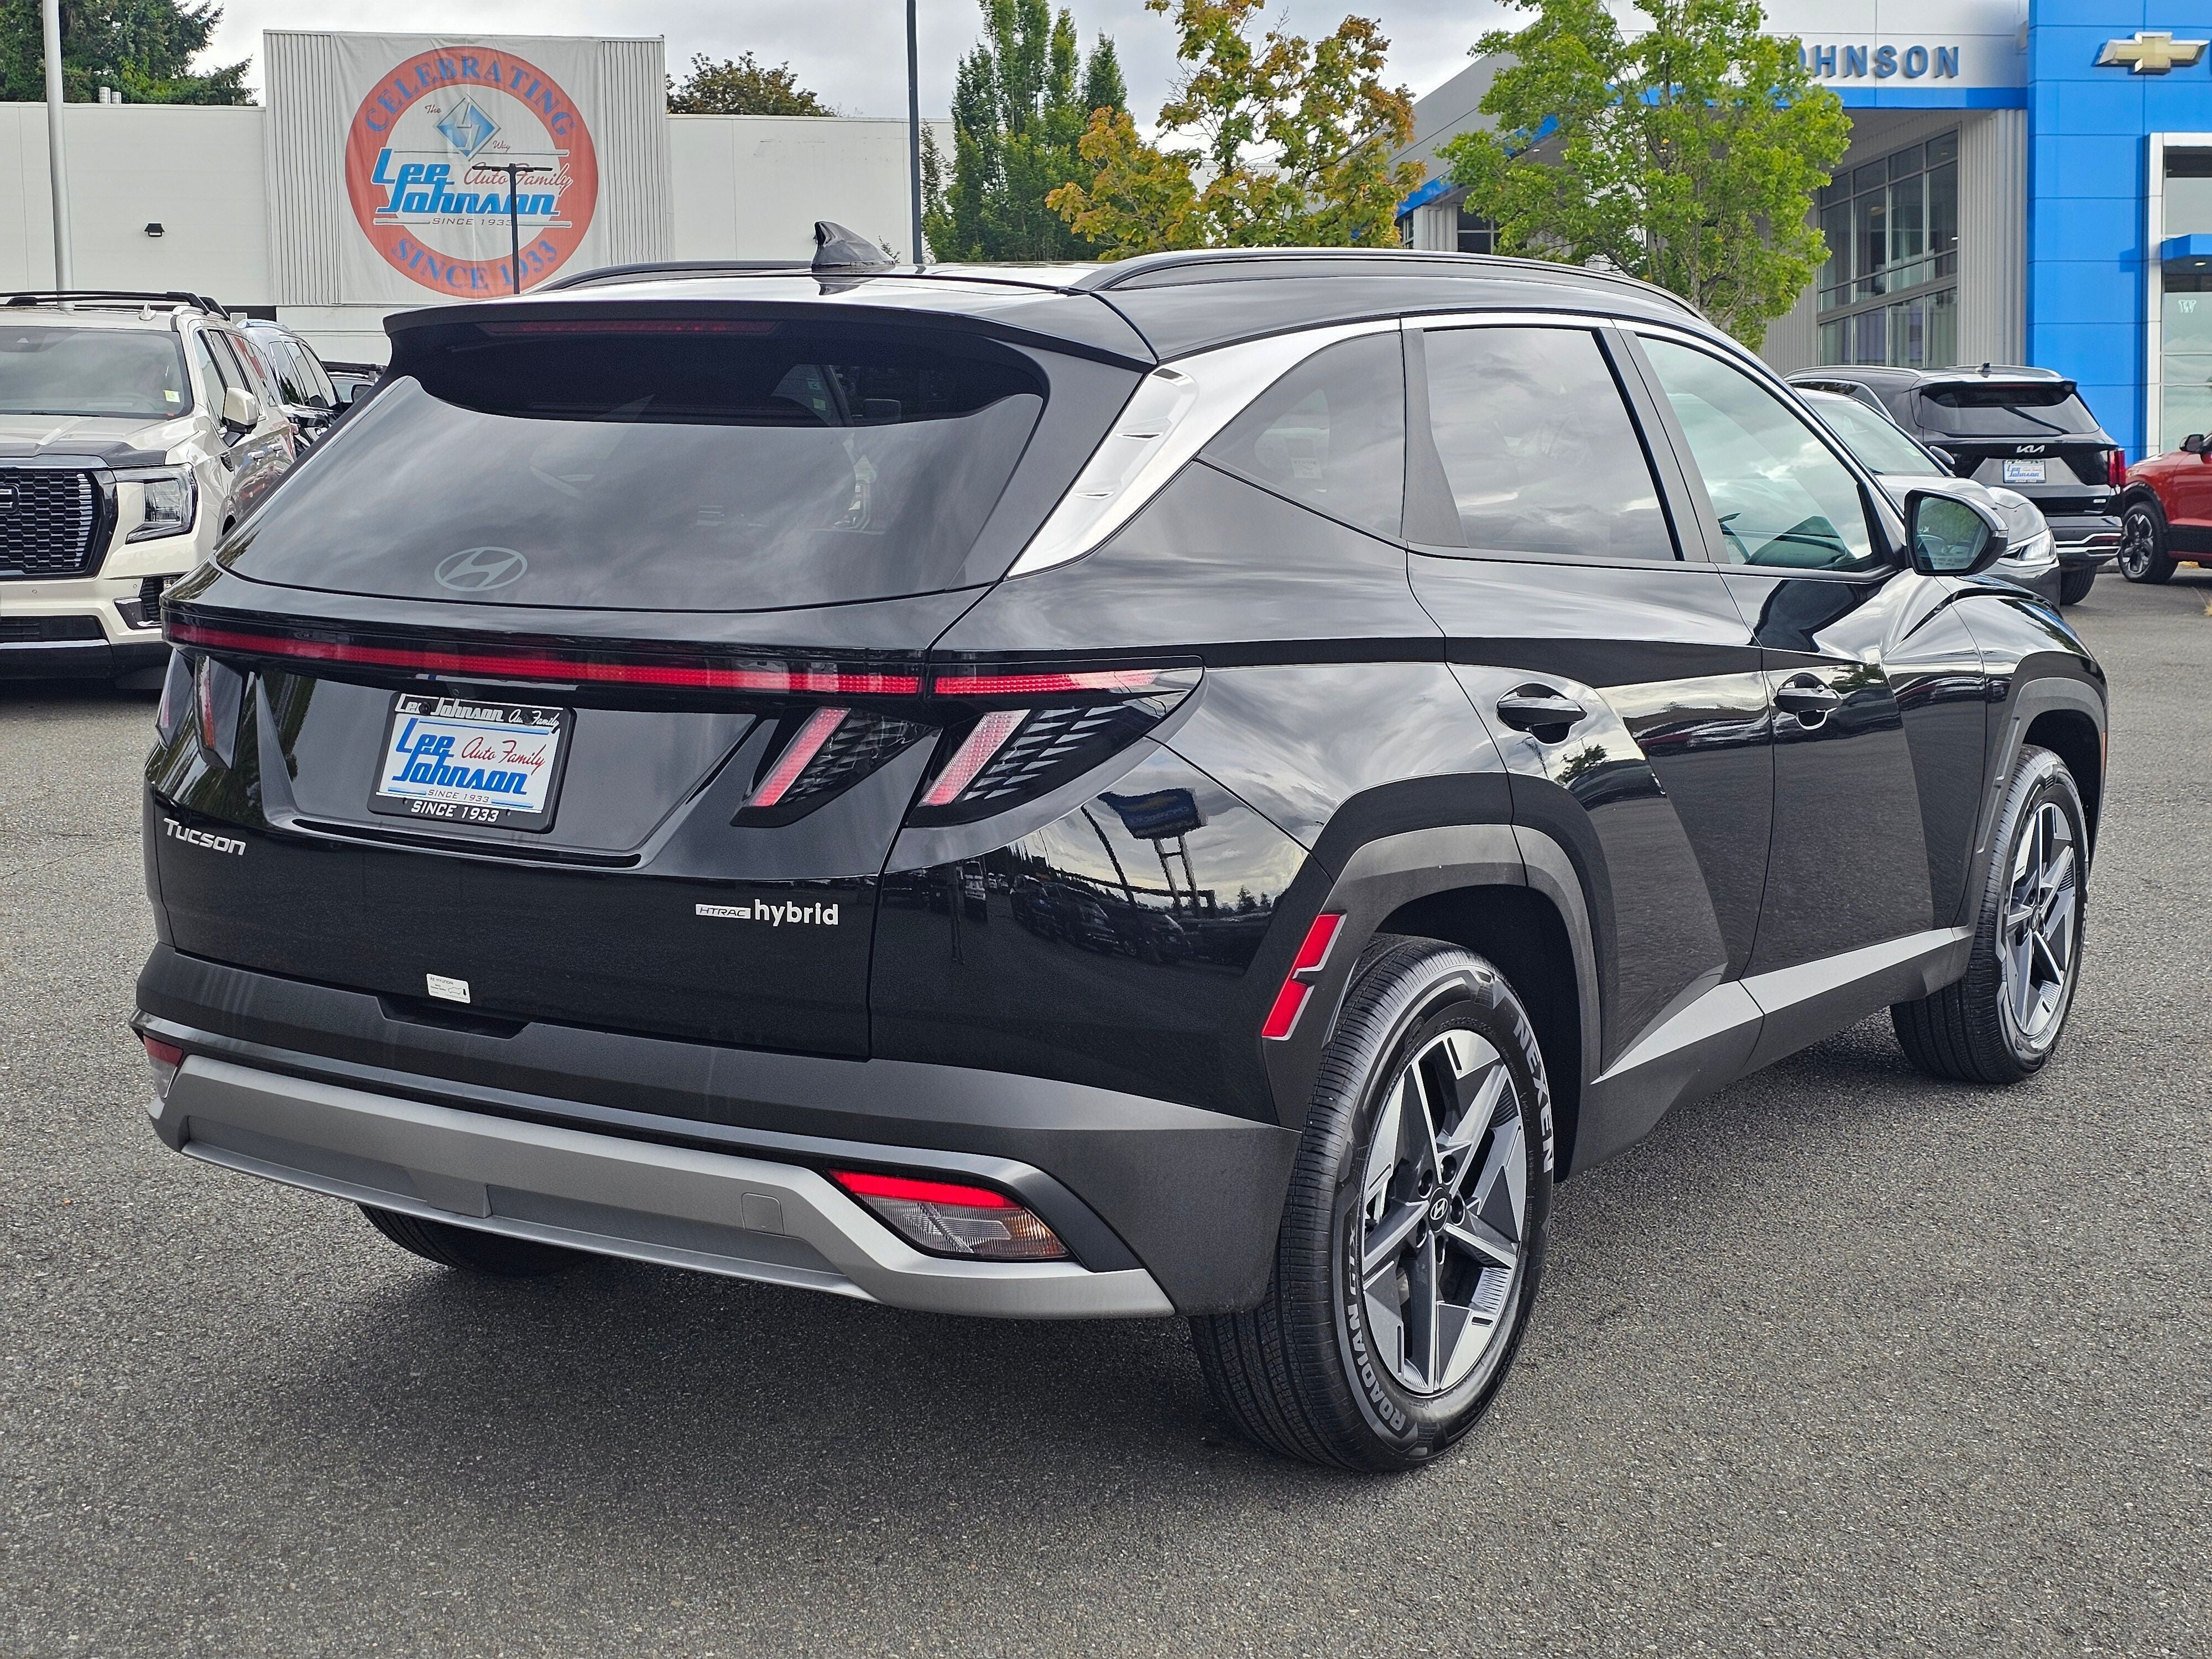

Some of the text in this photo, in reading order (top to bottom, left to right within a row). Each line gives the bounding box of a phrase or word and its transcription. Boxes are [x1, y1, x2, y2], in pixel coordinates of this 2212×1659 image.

[1798, 45, 1959, 79] HNSON
[366, 56, 576, 135] CELEBRATING
[425, 104, 442, 114] The
[492, 140, 511, 153] Way
[373, 149, 455, 185] Lee
[463, 161, 573, 195] Auto Family
[377, 180, 560, 215] Johnson
[392, 238, 489, 290] SINCE
[430, 697, 505, 722] Johnson
[531, 710, 560, 734] Family
[395, 717, 455, 758] Lee
[392, 753, 528, 795] Johnson
[461, 737, 546, 775] Auto Family
[411, 801, 499, 823] SINCE 1933
[427, 789, 489, 803] SINCE 1933
[700, 899, 838, 927] HTRAC hybrid
[1513, 1015, 1553, 1173] NEXEN
[1348, 1303, 1407, 1432] ROADIAN
